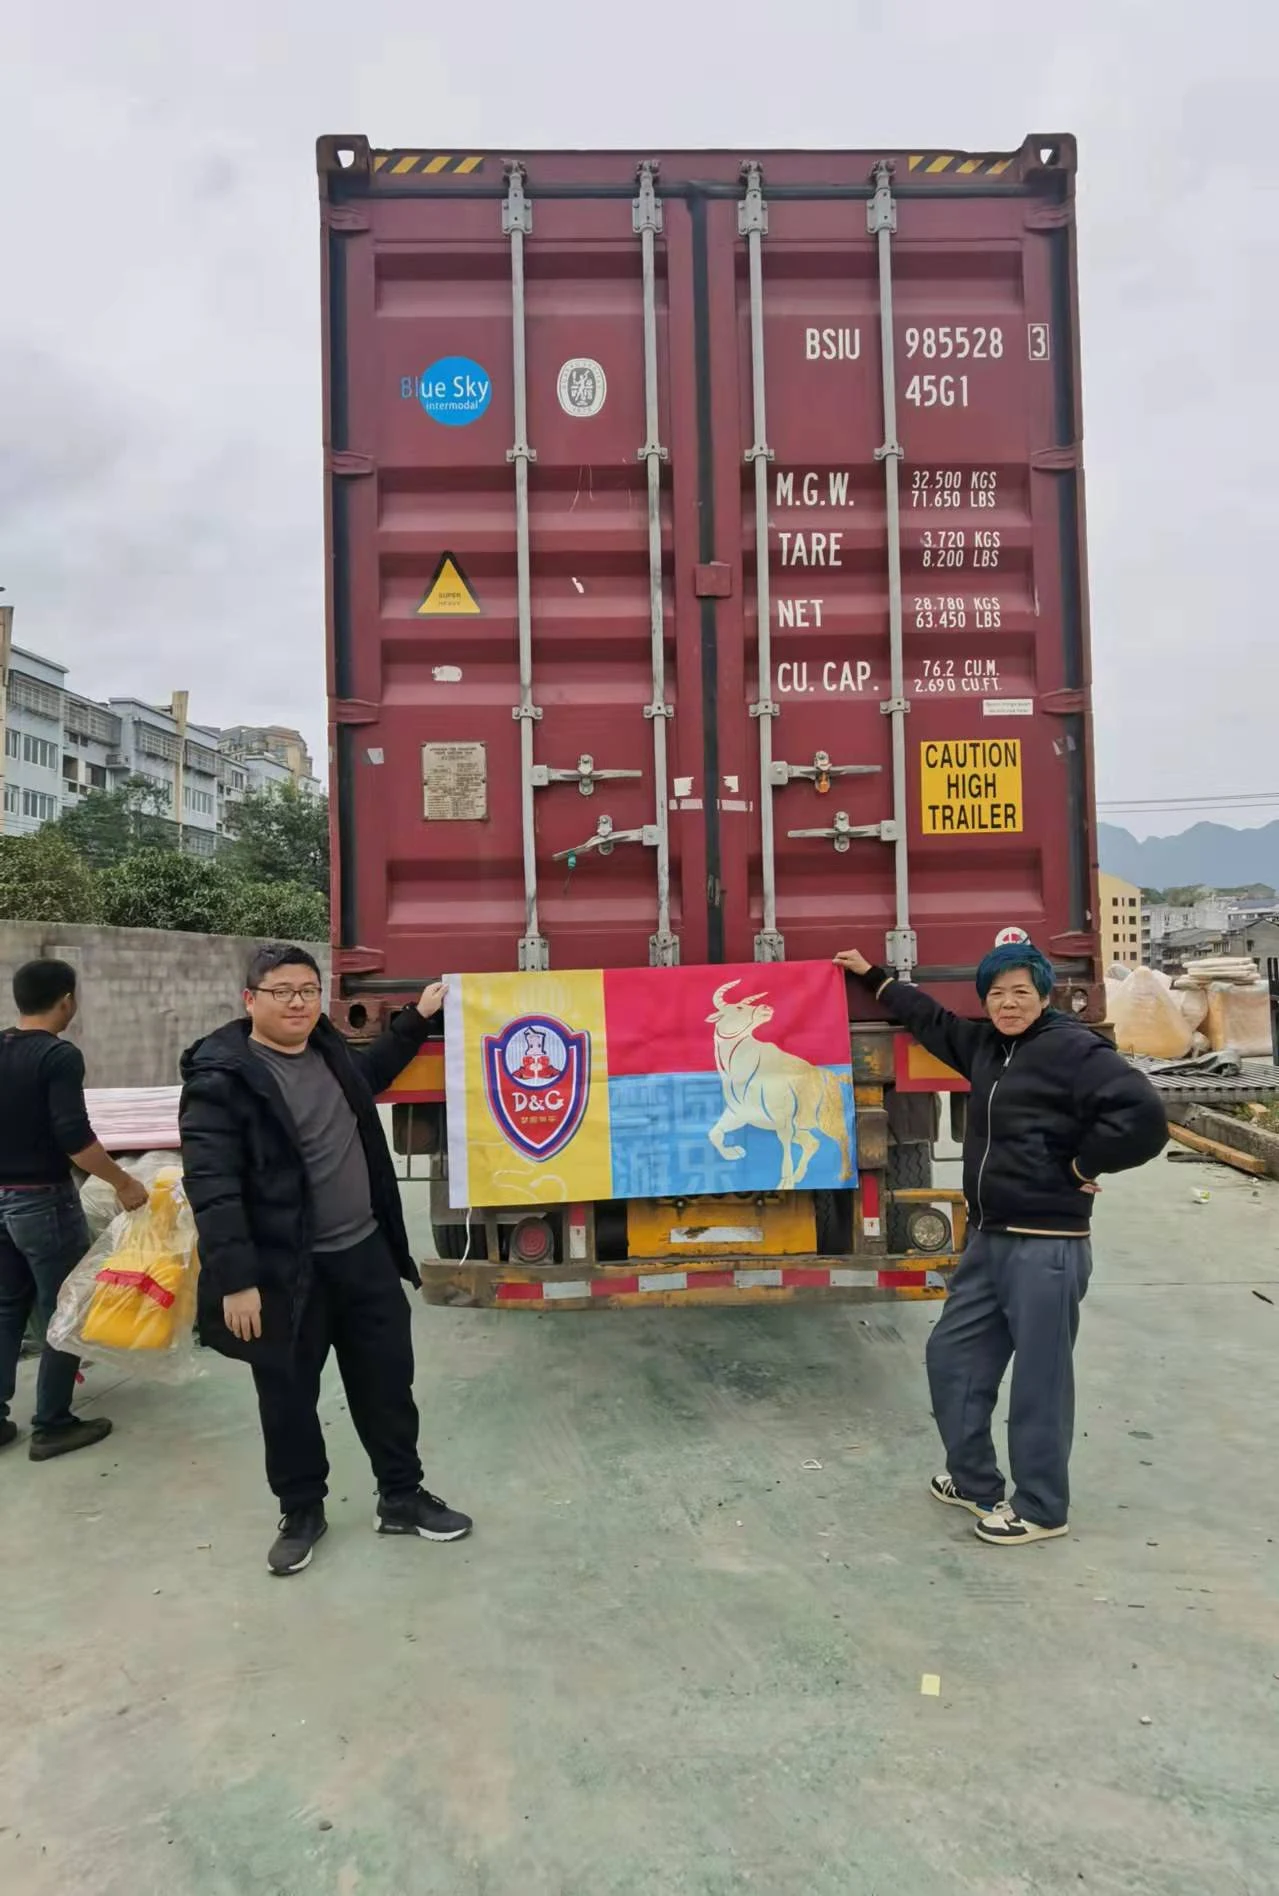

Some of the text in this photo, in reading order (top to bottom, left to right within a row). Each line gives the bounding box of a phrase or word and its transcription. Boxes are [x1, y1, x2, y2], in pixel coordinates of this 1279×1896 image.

[805, 326, 1046, 360] BSIU 985528 3
[401, 375, 489, 403] Blue Sky
[905, 375, 969, 407] 45G1
[425, 400, 479, 410] intermodal
[776, 472, 854, 506] M.G.W.
[912, 471, 997, 489] 32.500 KGS
[911, 490, 996, 508] 71.650 LBS
[778, 532, 844, 567] TARE
[923, 531, 1001, 548] 3.720 KGS
[922, 549, 999, 567] 8.200 LBS
[777, 599, 823, 628] NET
[914, 597, 1001, 611] 28.780 KGS
[915, 611, 1001, 628] 63.450 LBS
[777, 661, 879, 692] CU. CAP.
[922, 659, 1000, 677] 76.2 CU.M.
[914, 679, 956, 693] 2.690
[925, 742, 1017, 769] CAUTION
[947, 773, 997, 799] HIGH
[928, 803, 1017, 830] TRAILER
